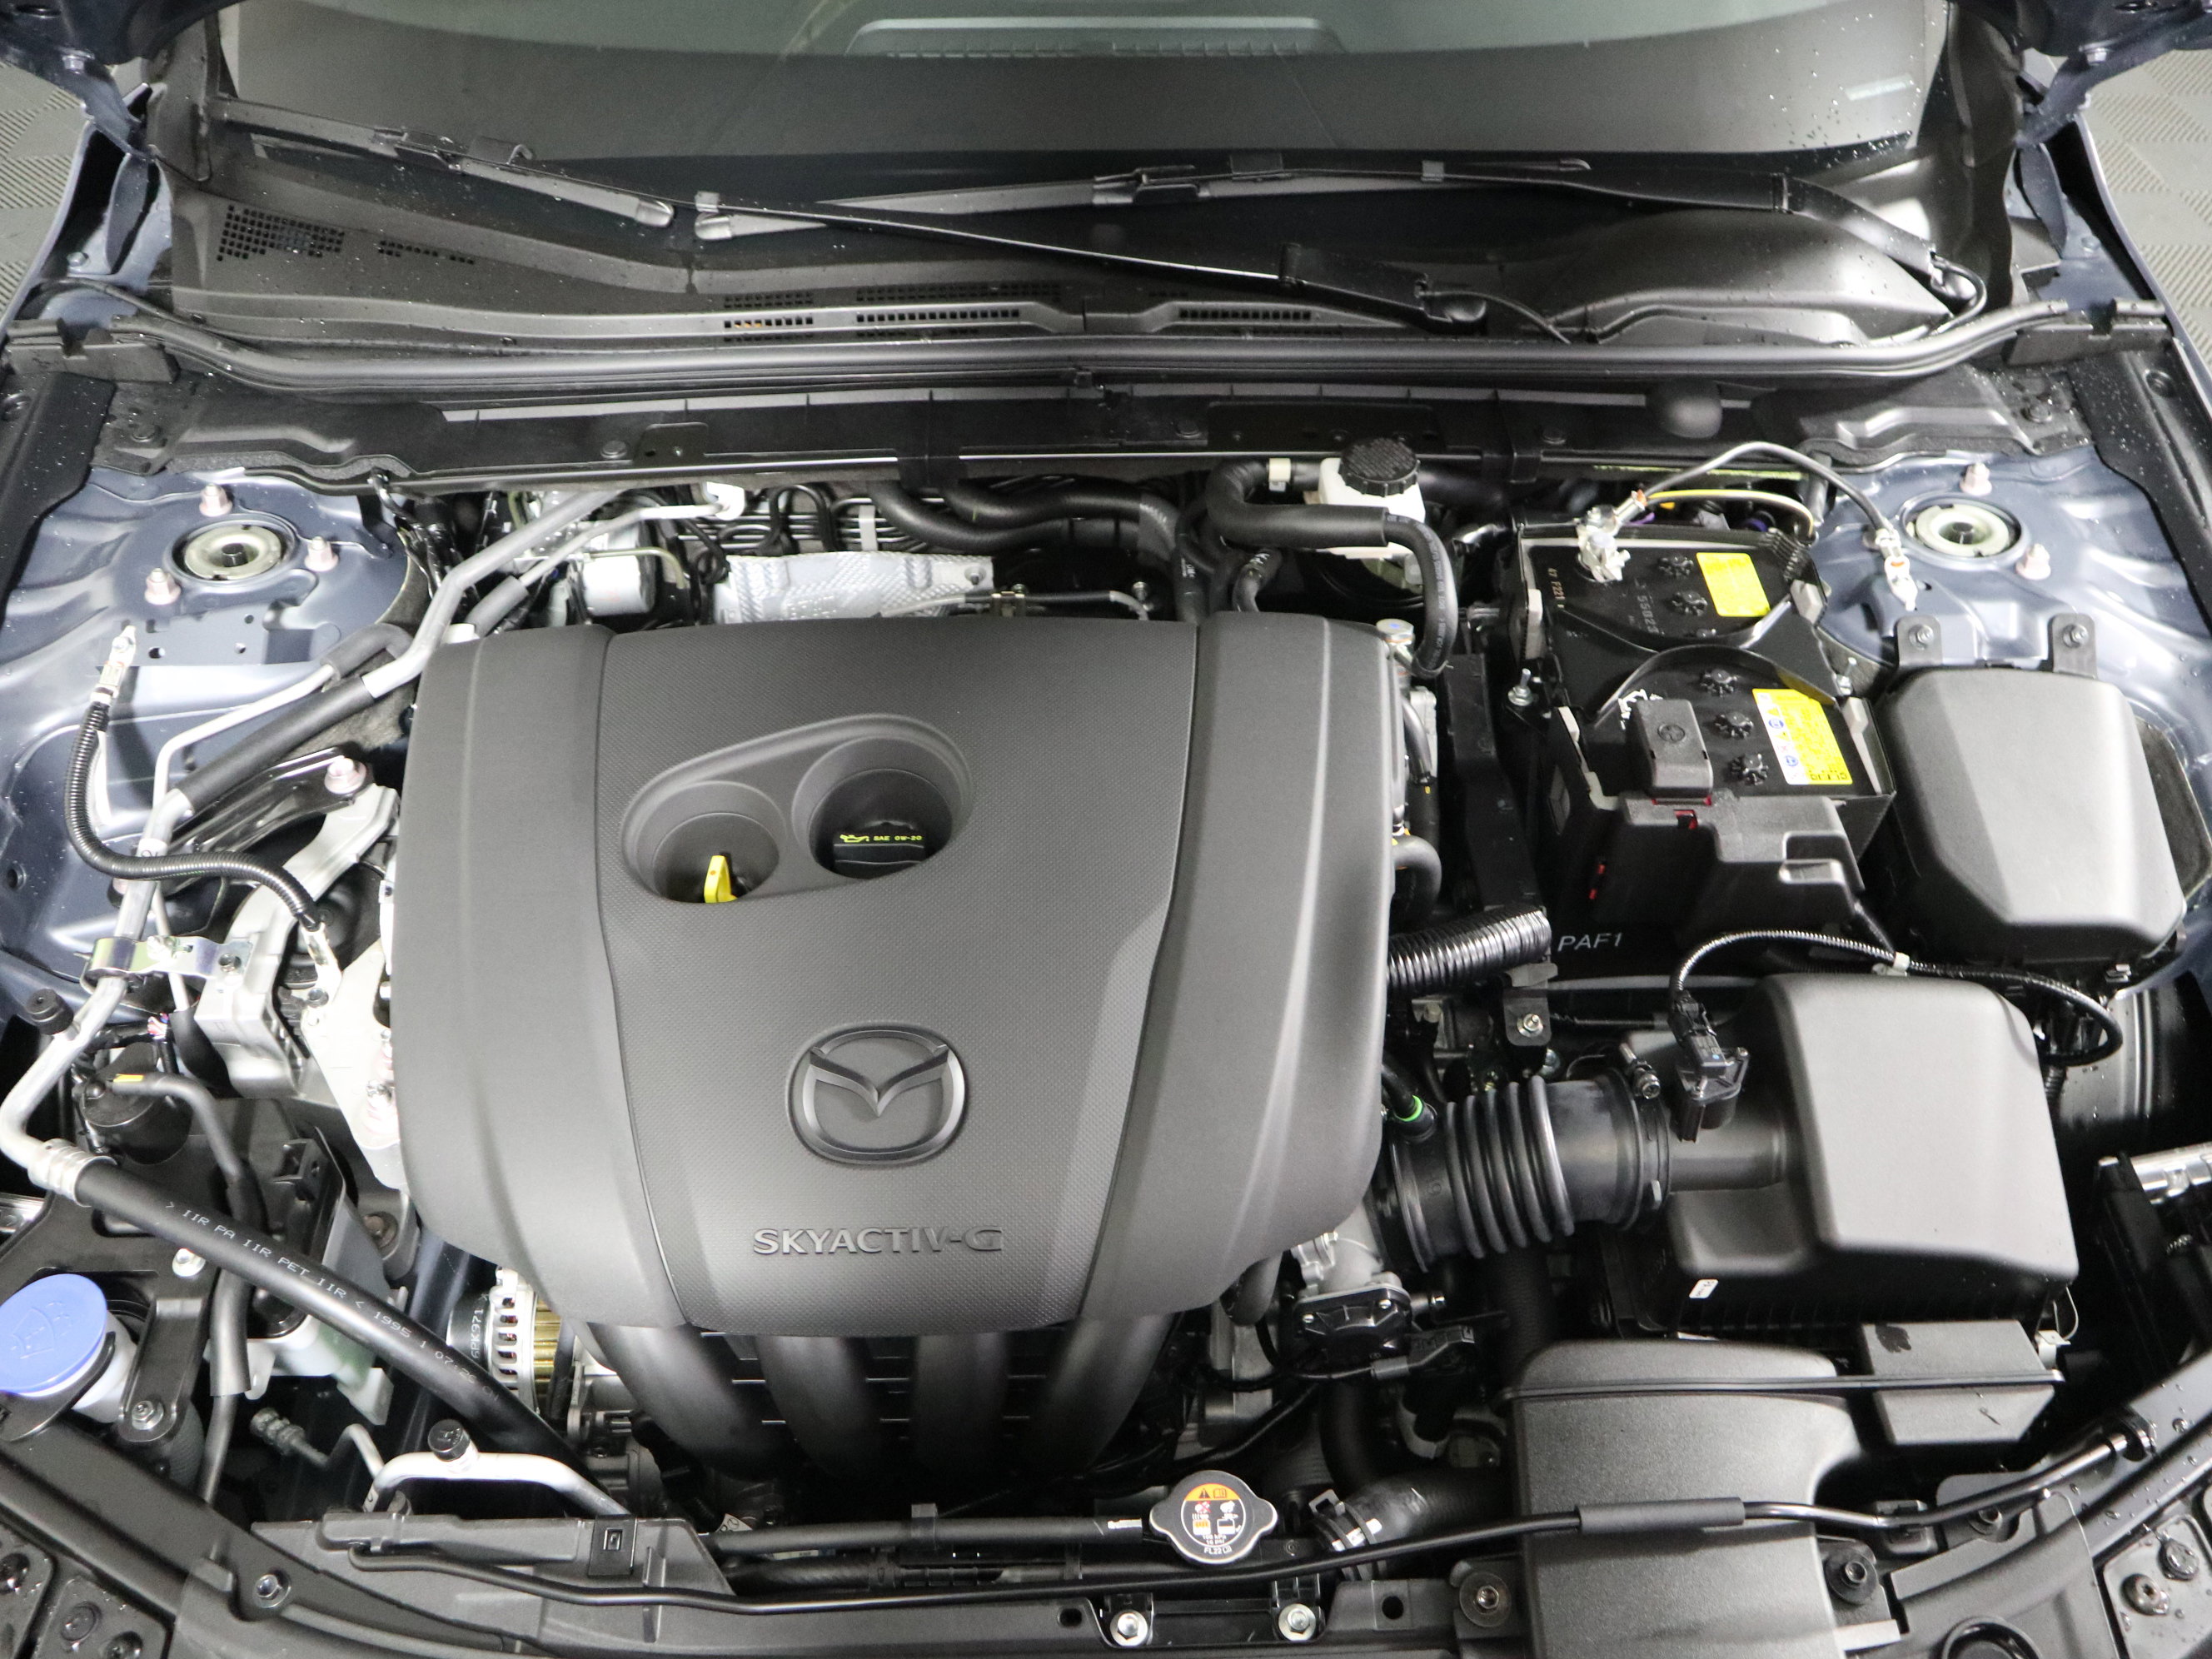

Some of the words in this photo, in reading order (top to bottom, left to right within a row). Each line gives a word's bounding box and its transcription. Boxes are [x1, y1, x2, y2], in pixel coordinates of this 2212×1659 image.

[1557, 932, 1622, 952] PAF1
[753, 1226, 1003, 1255] SKYACTIV-G
[182, 1210, 211, 1225] IIR
[214, 1225, 237, 1239] PA
[243, 1239, 272, 1258] IIR
[277, 1257, 311, 1276] PET
[317, 1278, 346, 1299] IIR
[374, 1312, 412, 1338] 1995
[471, 1308, 484, 1359] 6PK971
[1203, 1547, 1223, 1555] FL22
